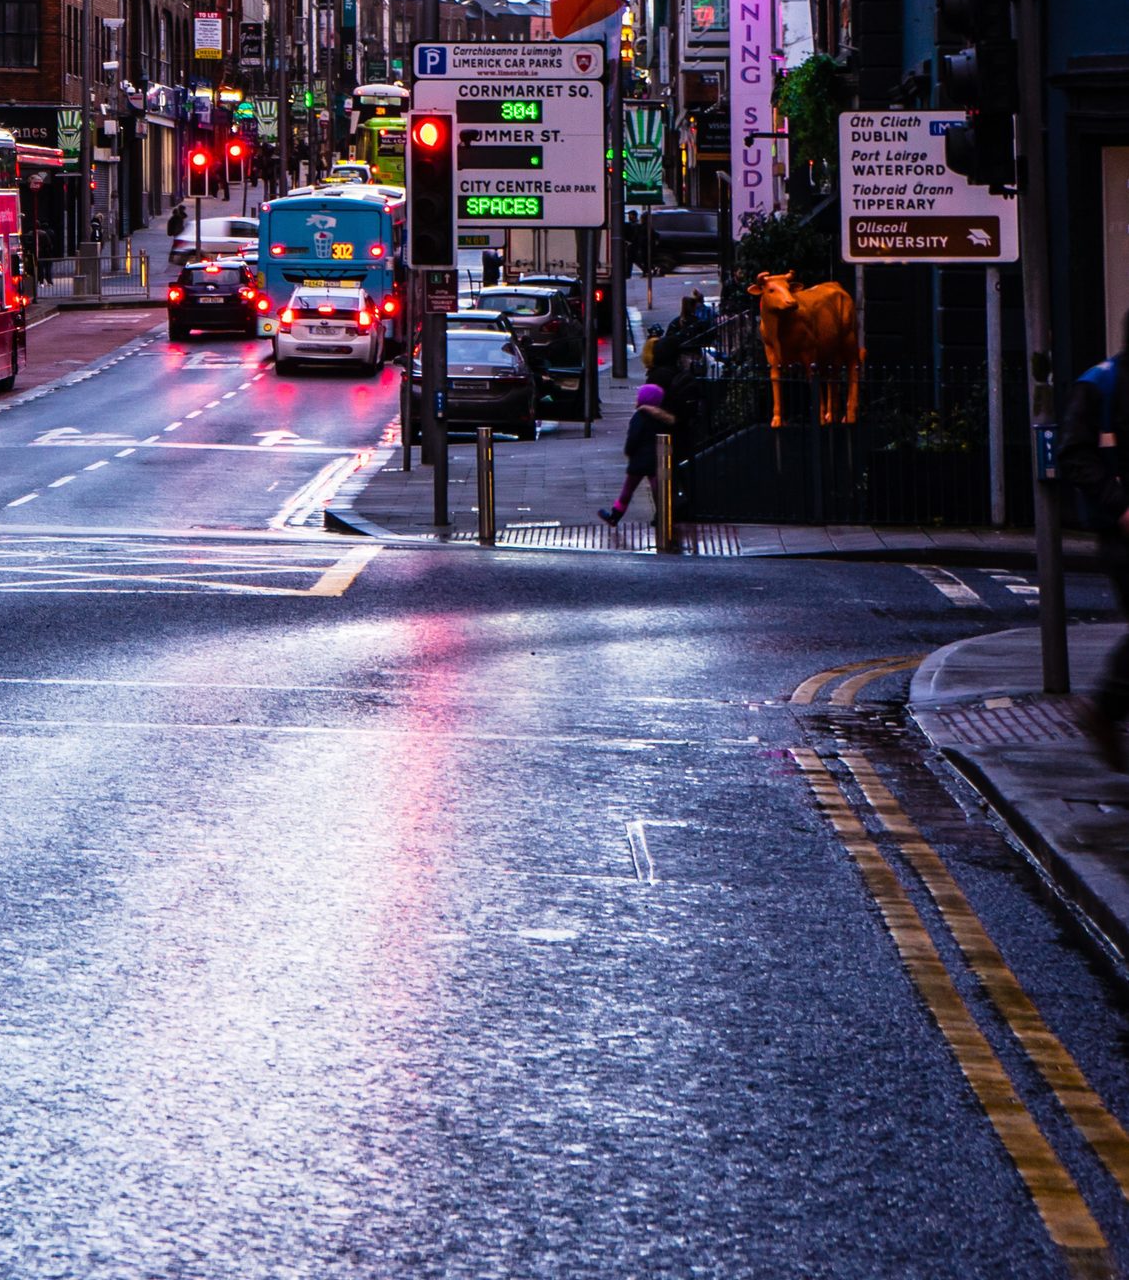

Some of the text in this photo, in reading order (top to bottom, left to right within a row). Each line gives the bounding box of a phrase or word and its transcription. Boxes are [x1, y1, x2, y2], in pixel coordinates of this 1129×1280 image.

[521, 46, 562, 58] Luimnigh
[453, 58, 562, 68] LIMERICK CAR PARKS
[458, 85, 593, 98] CORNMARKET SQ.
[501, 102, 538, 120] 304
[880, 116, 921, 127] Cliath
[464, 130, 564, 142] UMMER ST.
[851, 131, 908, 142] DUBLIN
[851, 150, 880, 161] Port
[853, 165, 946, 176] WATERFORD
[460, 180, 597, 193] CITY CENTRE CAR PARK
[852, 183, 907, 195] Tiobraid
[466, 197, 539, 215] SPACES
[853, 199, 935, 210] TIPPERARY
[856, 221, 908, 233] Ollscoil
[857, 236, 948, 248] UNIVERSITY
[332, 243, 353, 260] 302
